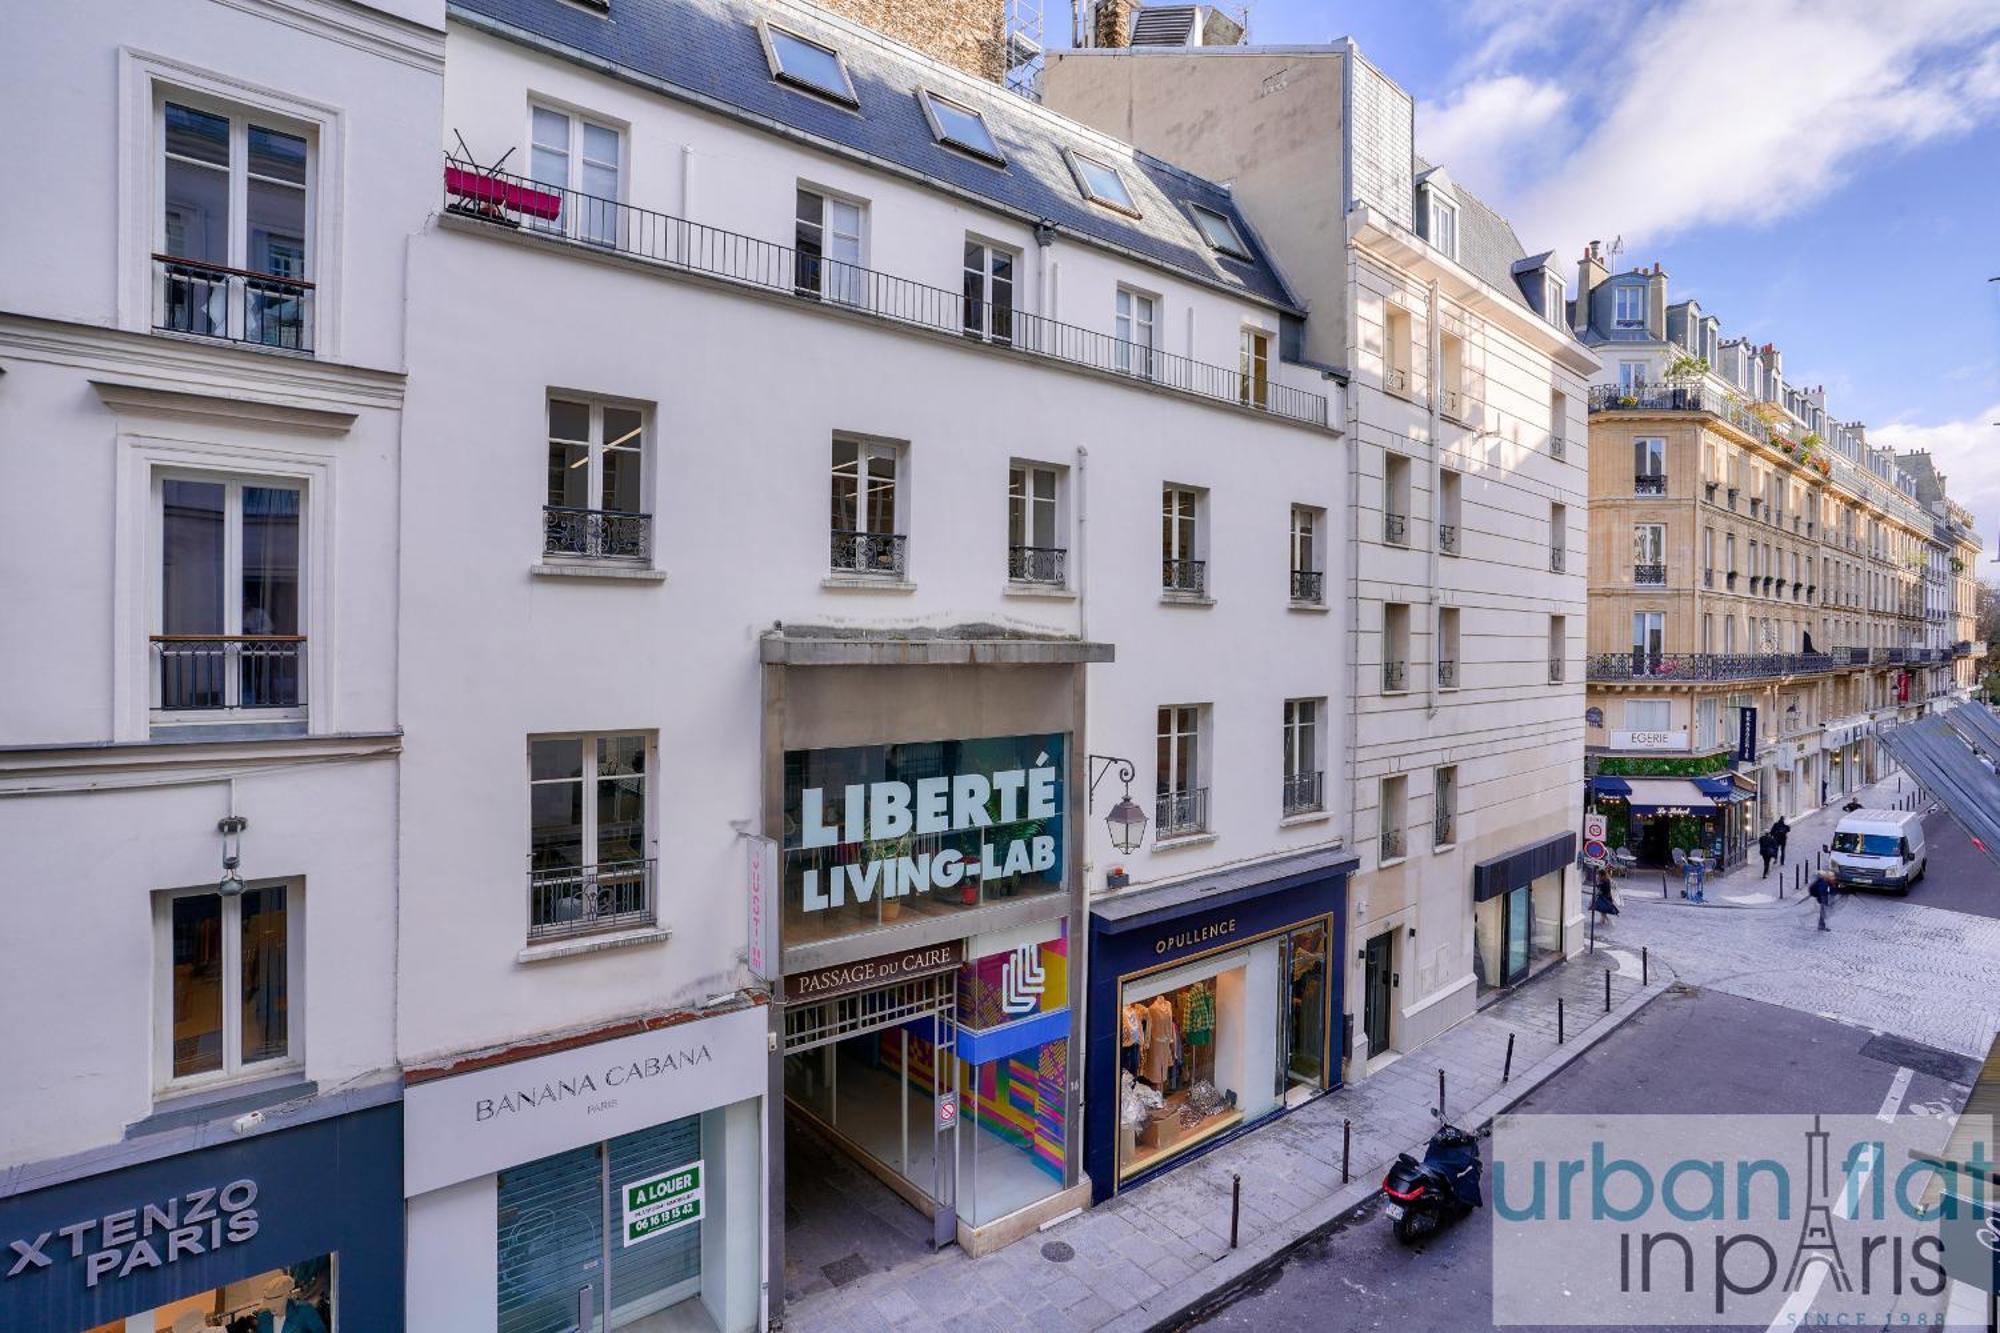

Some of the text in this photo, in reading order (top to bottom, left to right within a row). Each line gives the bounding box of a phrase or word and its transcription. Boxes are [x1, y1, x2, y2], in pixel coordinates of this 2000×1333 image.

[802, 751, 1056, 849] LIBERTÉ
[1156, 918, 1236, 954] OPULLENCE
[799, 963, 875, 994] PASSAGE
[902, 947, 950, 971] CAIRE
[476, 1044, 713, 1122] BANANA CABANA
[586, 1099, 618, 1115] PARIS
[636, 1190, 646, 1205] A
[649, 1173, 692, 1200] LOUER
[87, 1209, 259, 1287] PARIS
